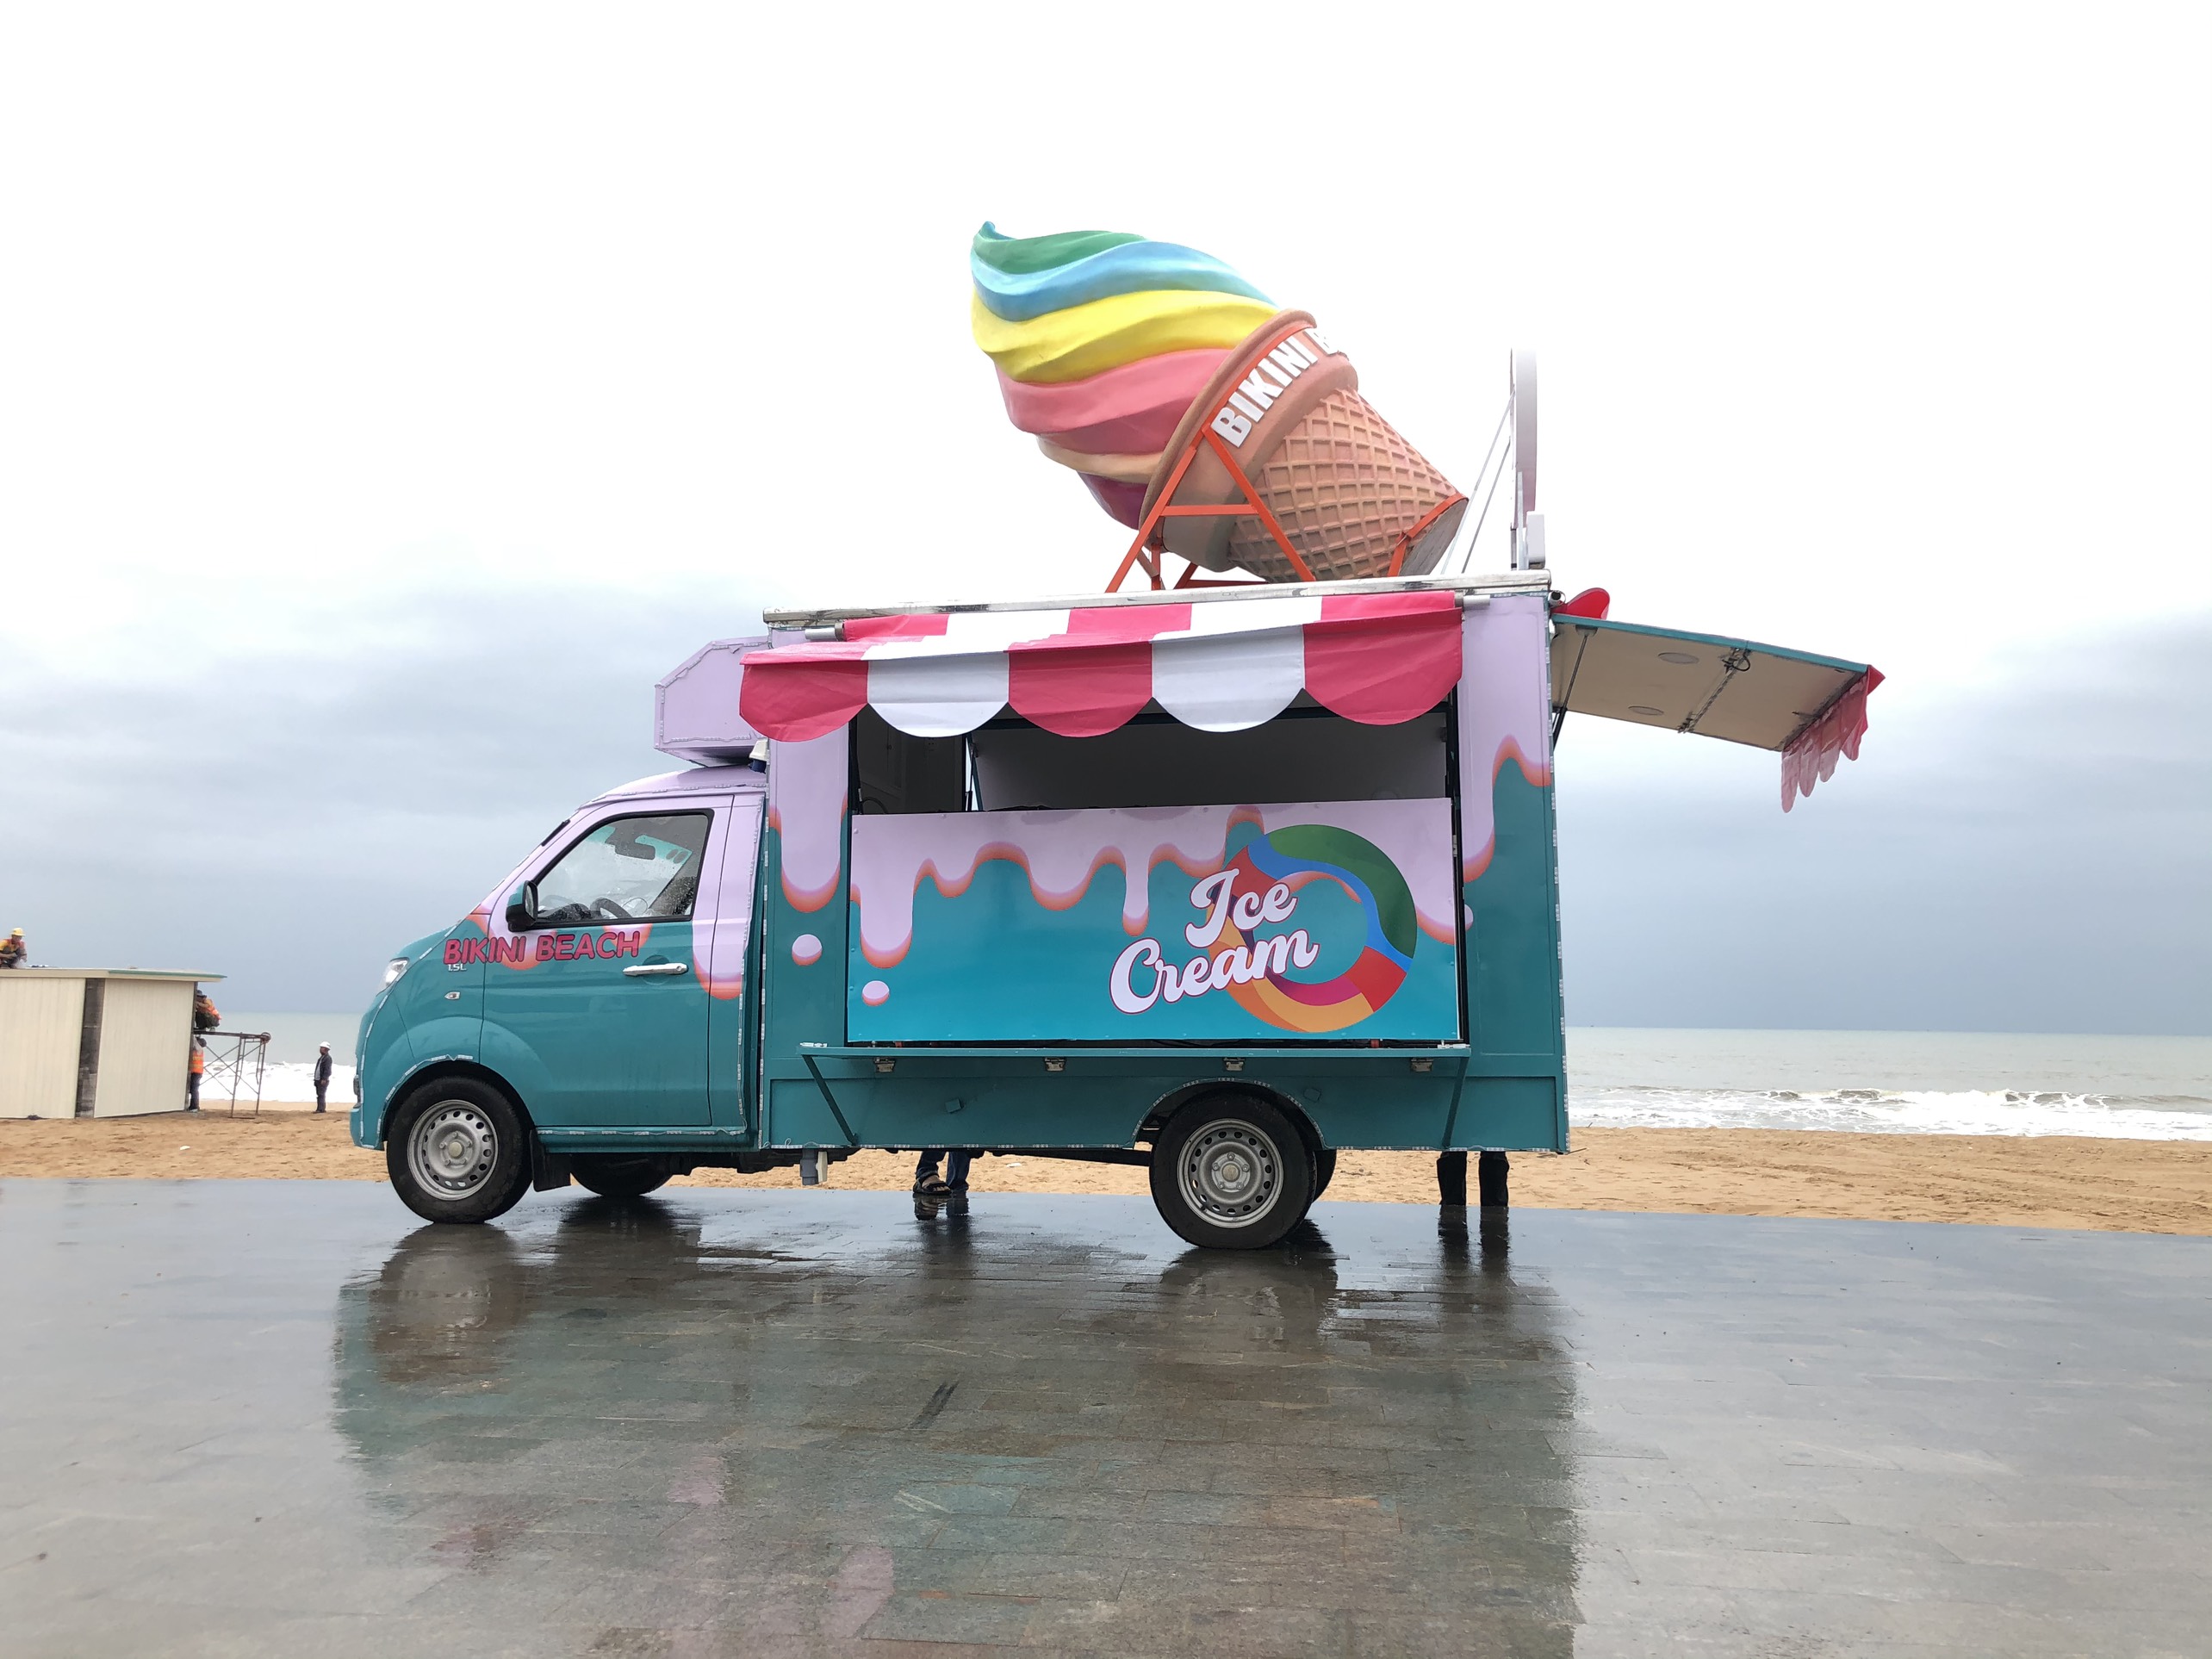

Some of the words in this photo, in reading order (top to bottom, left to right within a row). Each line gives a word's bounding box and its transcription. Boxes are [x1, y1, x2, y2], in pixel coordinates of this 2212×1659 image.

[1211, 336, 1319, 448] BIKINI
[444, 935, 527, 965] BIKINI
[536, 930, 641, 961] BEACH
[1185, 867, 1298, 949] Ice
[1109, 929, 1320, 1015] Cream
